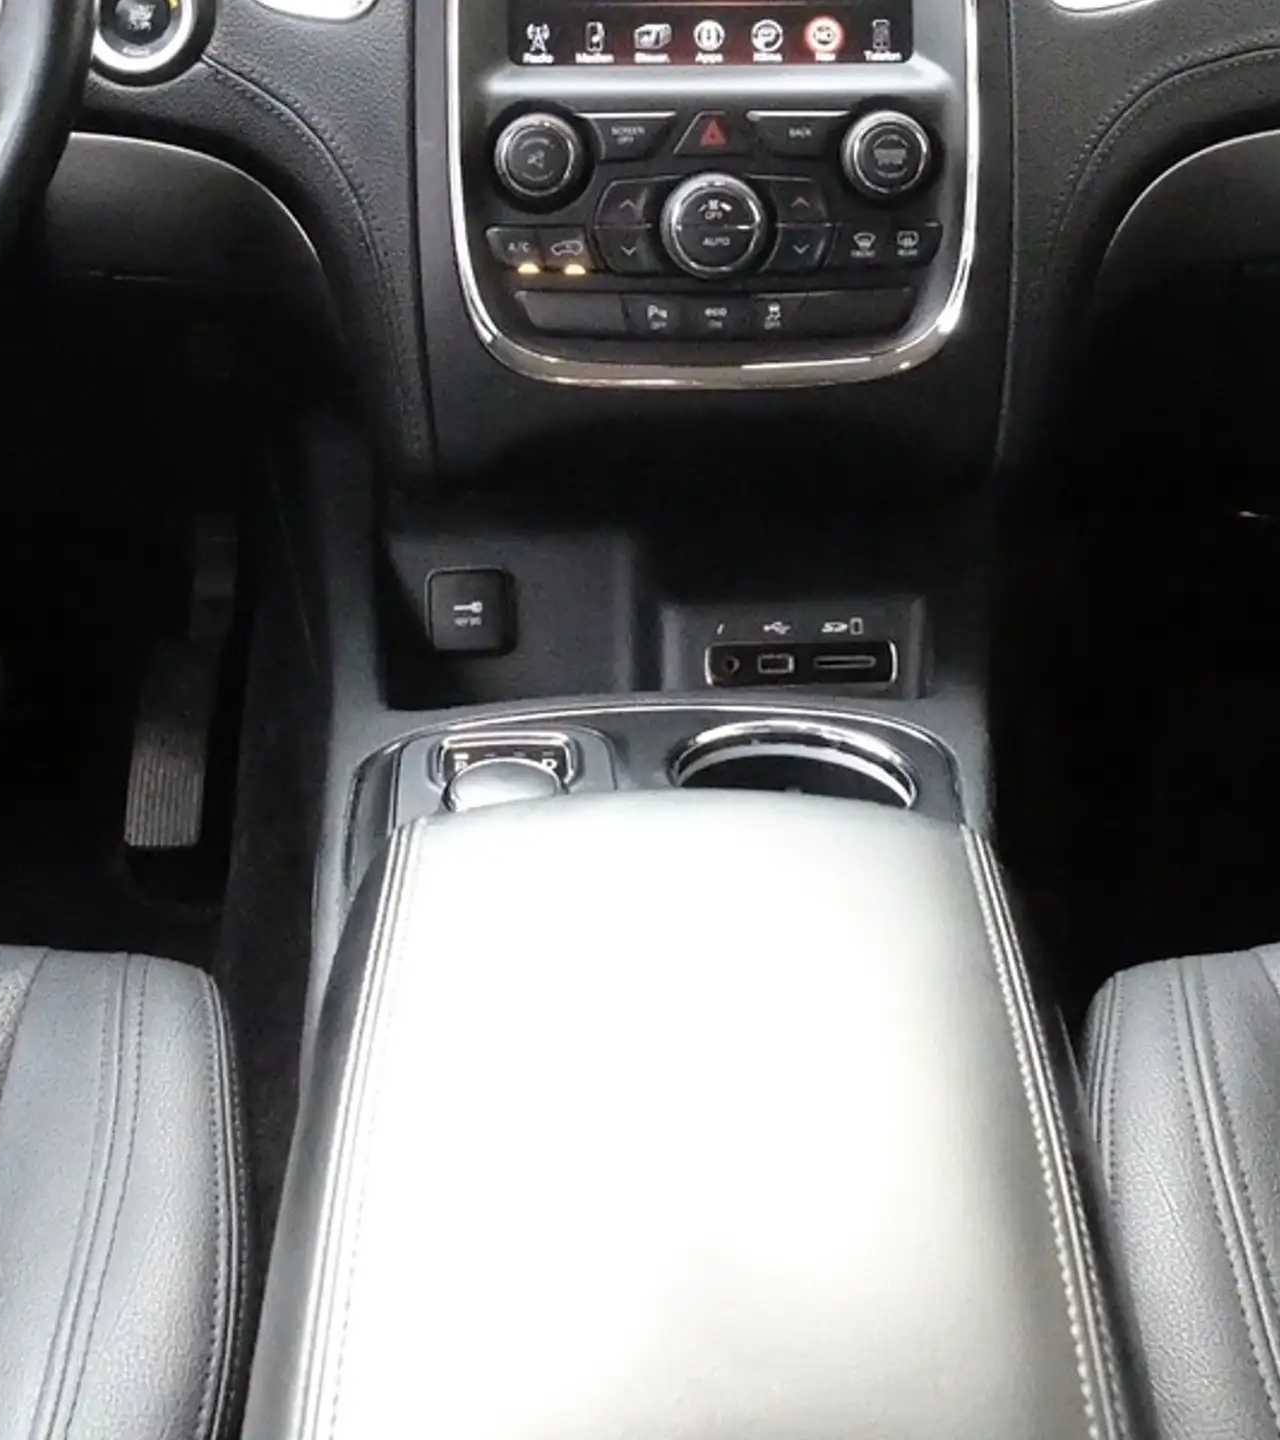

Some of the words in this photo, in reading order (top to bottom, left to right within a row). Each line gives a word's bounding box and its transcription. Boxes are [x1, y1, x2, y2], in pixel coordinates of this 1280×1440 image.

[863, 49, 903, 63] Telefon
[610, 126, 646, 136] SCREEN
[704, 211, 723, 221] OFF
[702, 236, 731, 247] AUTO
[507, 241, 531, 254] A/C
